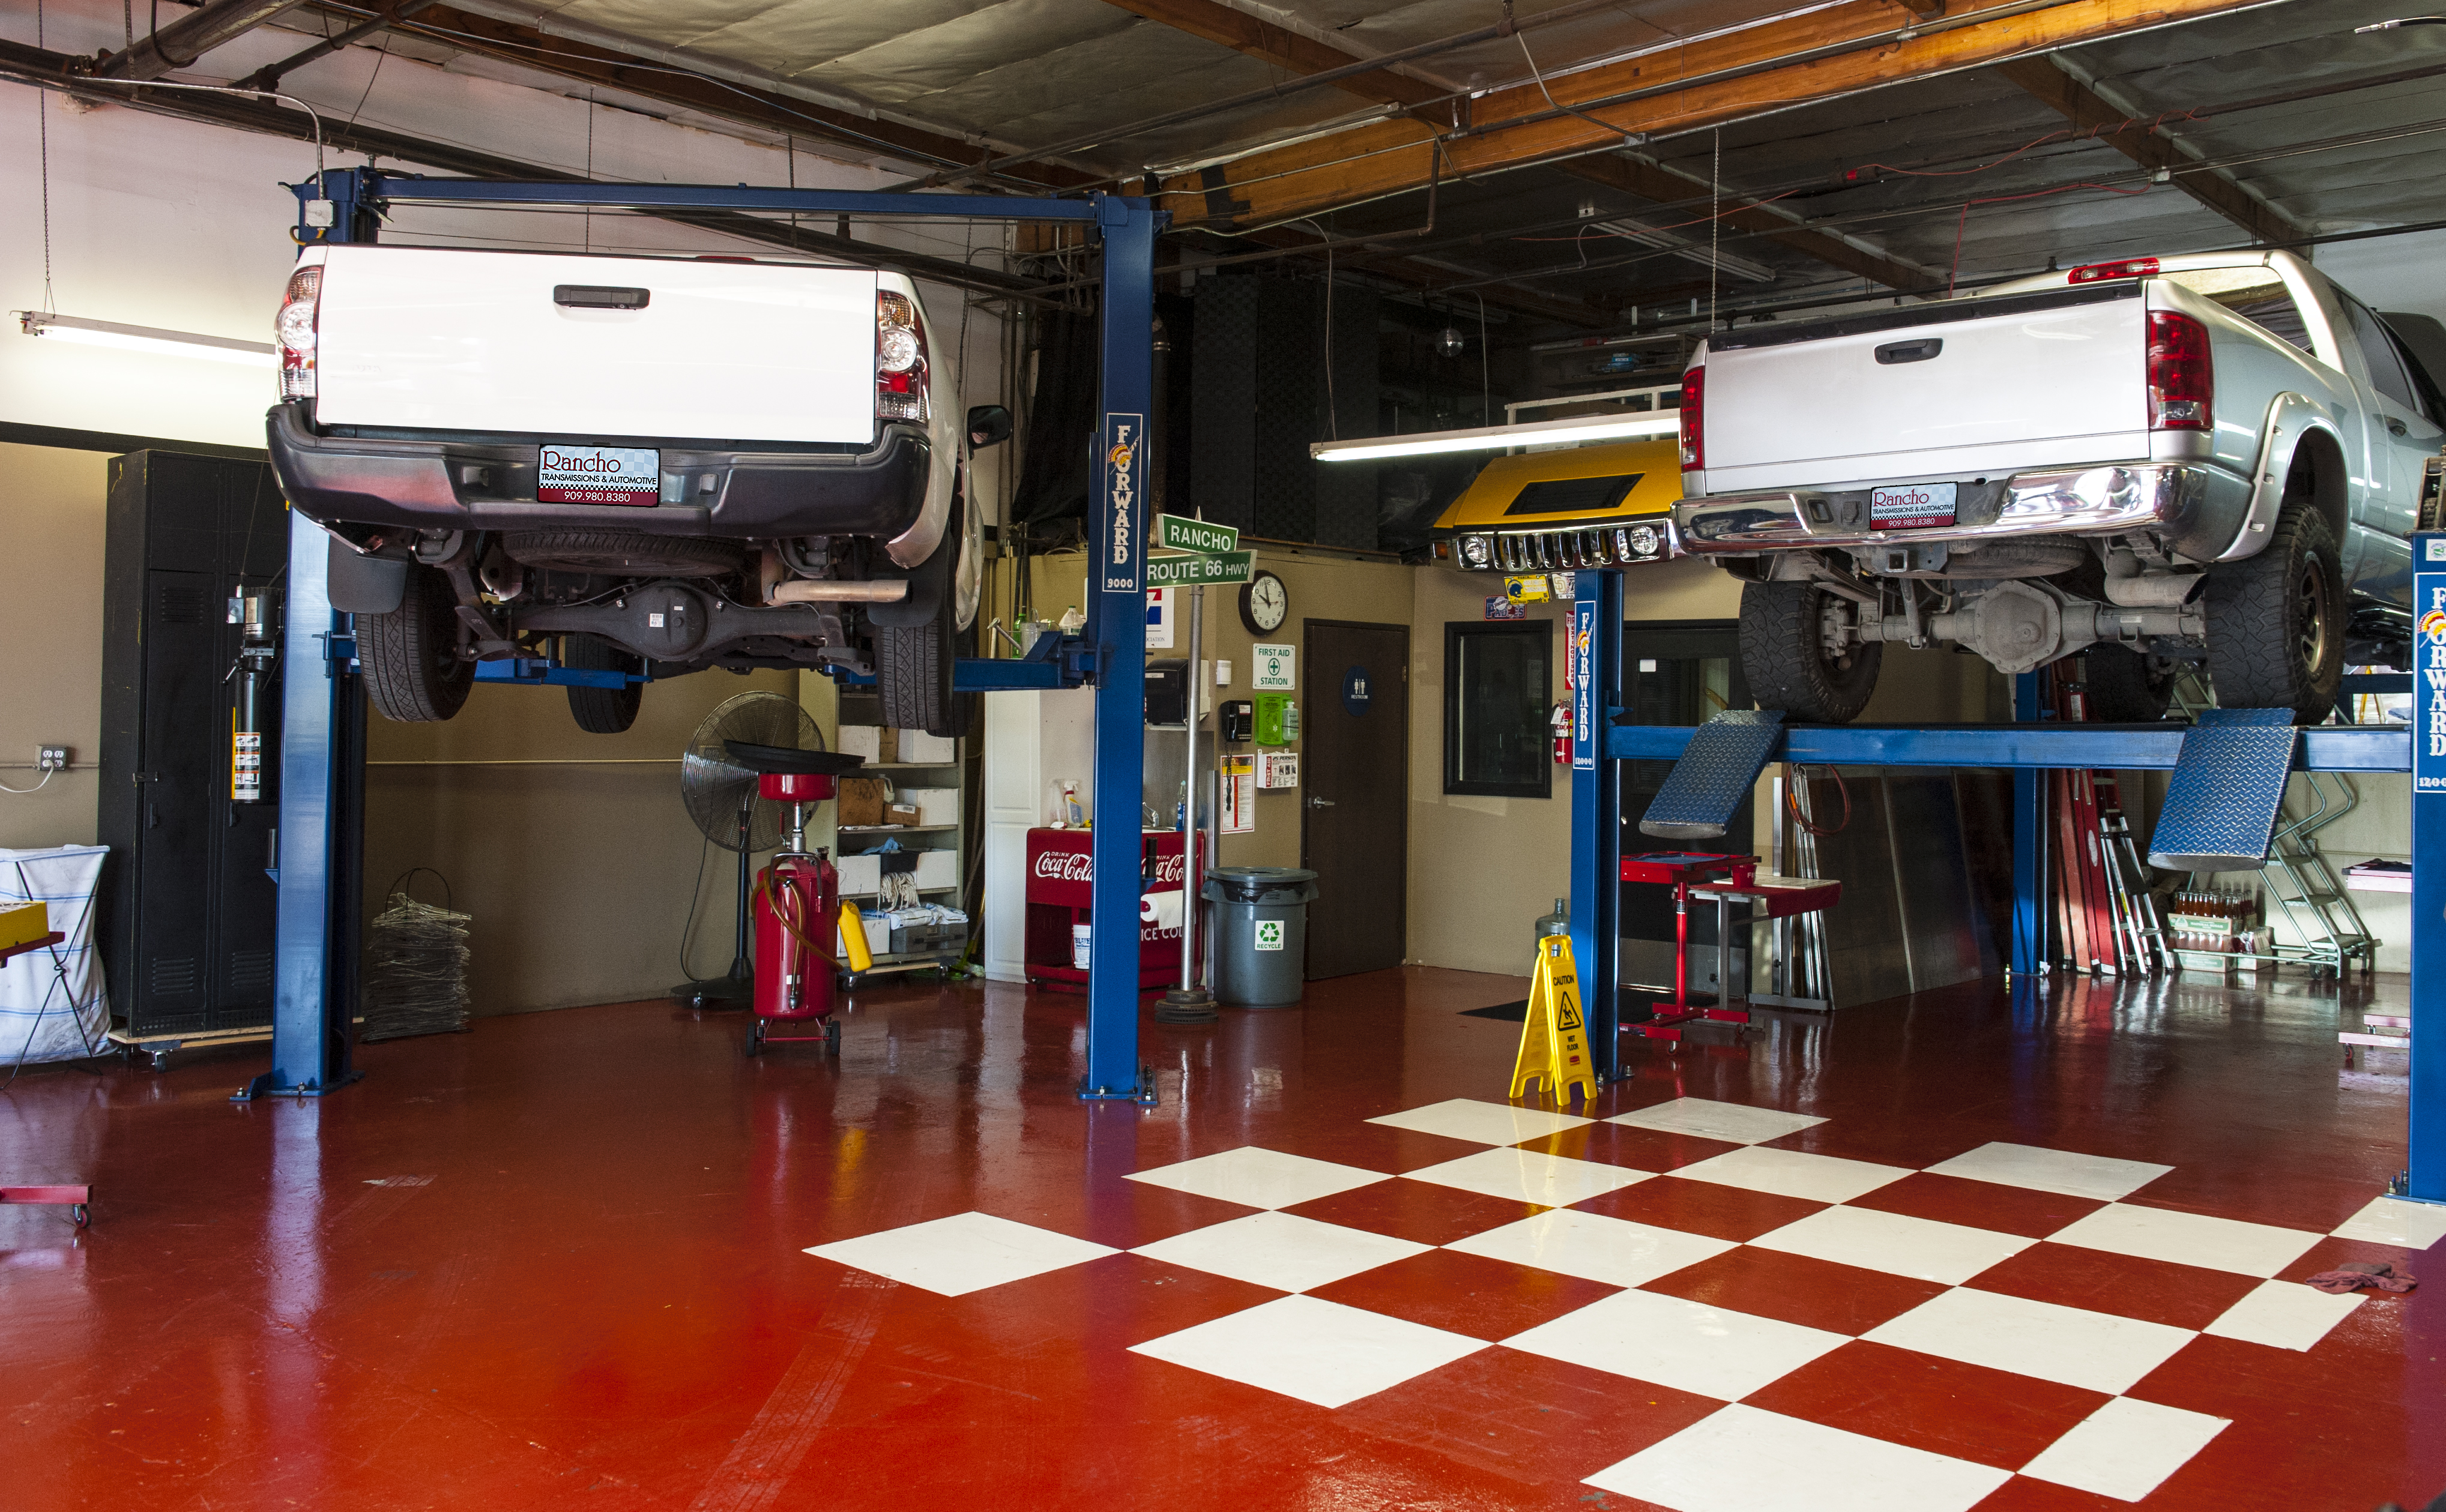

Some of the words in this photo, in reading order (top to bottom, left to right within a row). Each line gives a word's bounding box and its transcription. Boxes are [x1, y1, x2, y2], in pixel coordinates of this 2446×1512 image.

[542, 451, 621, 472] Rancho
[541, 474, 600, 483] TRANSMISSIONS
[609, 476, 656, 484] AUTOMOTIVE
[564, 491, 630, 502] 909.980.8380
[1112, 425, 1134, 564] FORWARD
[1873, 489, 1929, 507] Rancho
[1888, 518, 1935, 527] 909.980.8380
[1171, 525, 1231, 551] RANCHO
[1147, 561, 1199, 580] ROUTE
[1206, 560, 1222, 576] 66
[1226, 563, 1249, 576] HWY
[1107, 578, 1134, 588] 9000
[1487, 603, 1524, 618] PADES
[1578, 612, 1590, 741] FORWARD
[1141, 927, 1158, 941] ICE
[1162, 926, 1182, 939] COL
[1553, 975, 1574, 986] CAUTION
